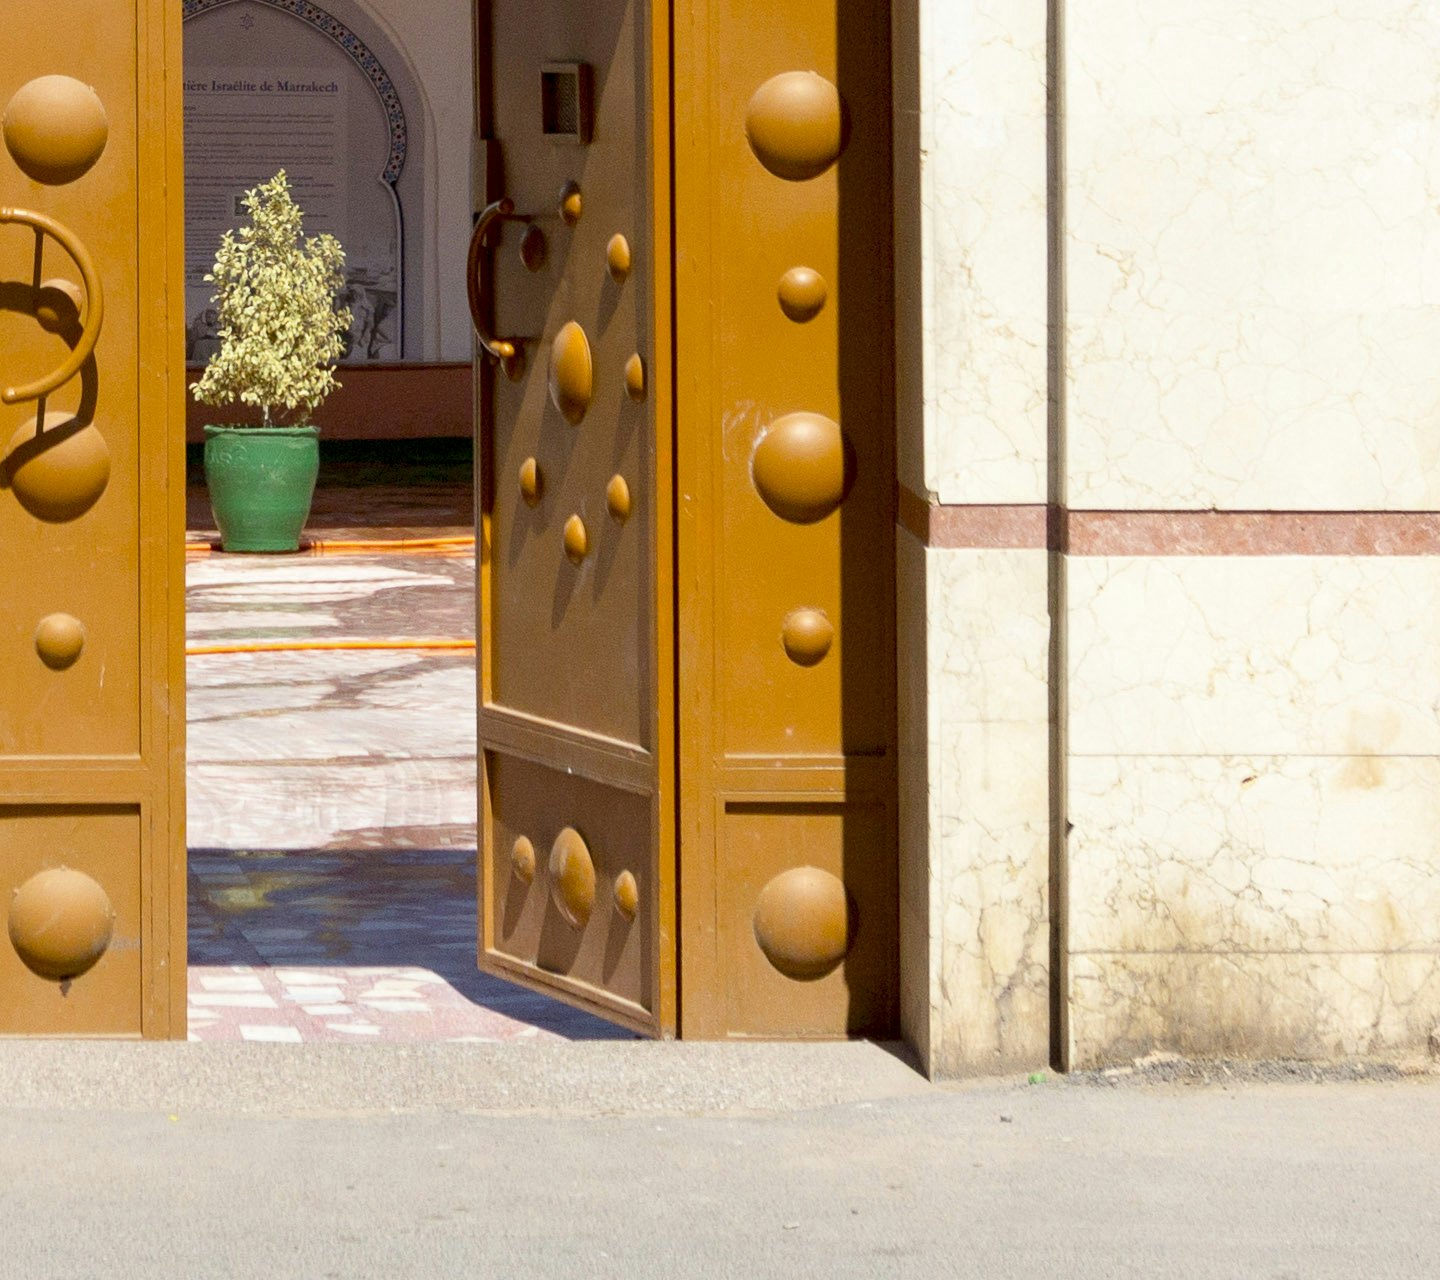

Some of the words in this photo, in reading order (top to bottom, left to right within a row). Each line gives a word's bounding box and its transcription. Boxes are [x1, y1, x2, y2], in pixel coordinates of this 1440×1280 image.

[212, 80, 256, 91] Israélite
[260, 81, 273, 91] de
[277, 81, 338, 92] Marrakech
